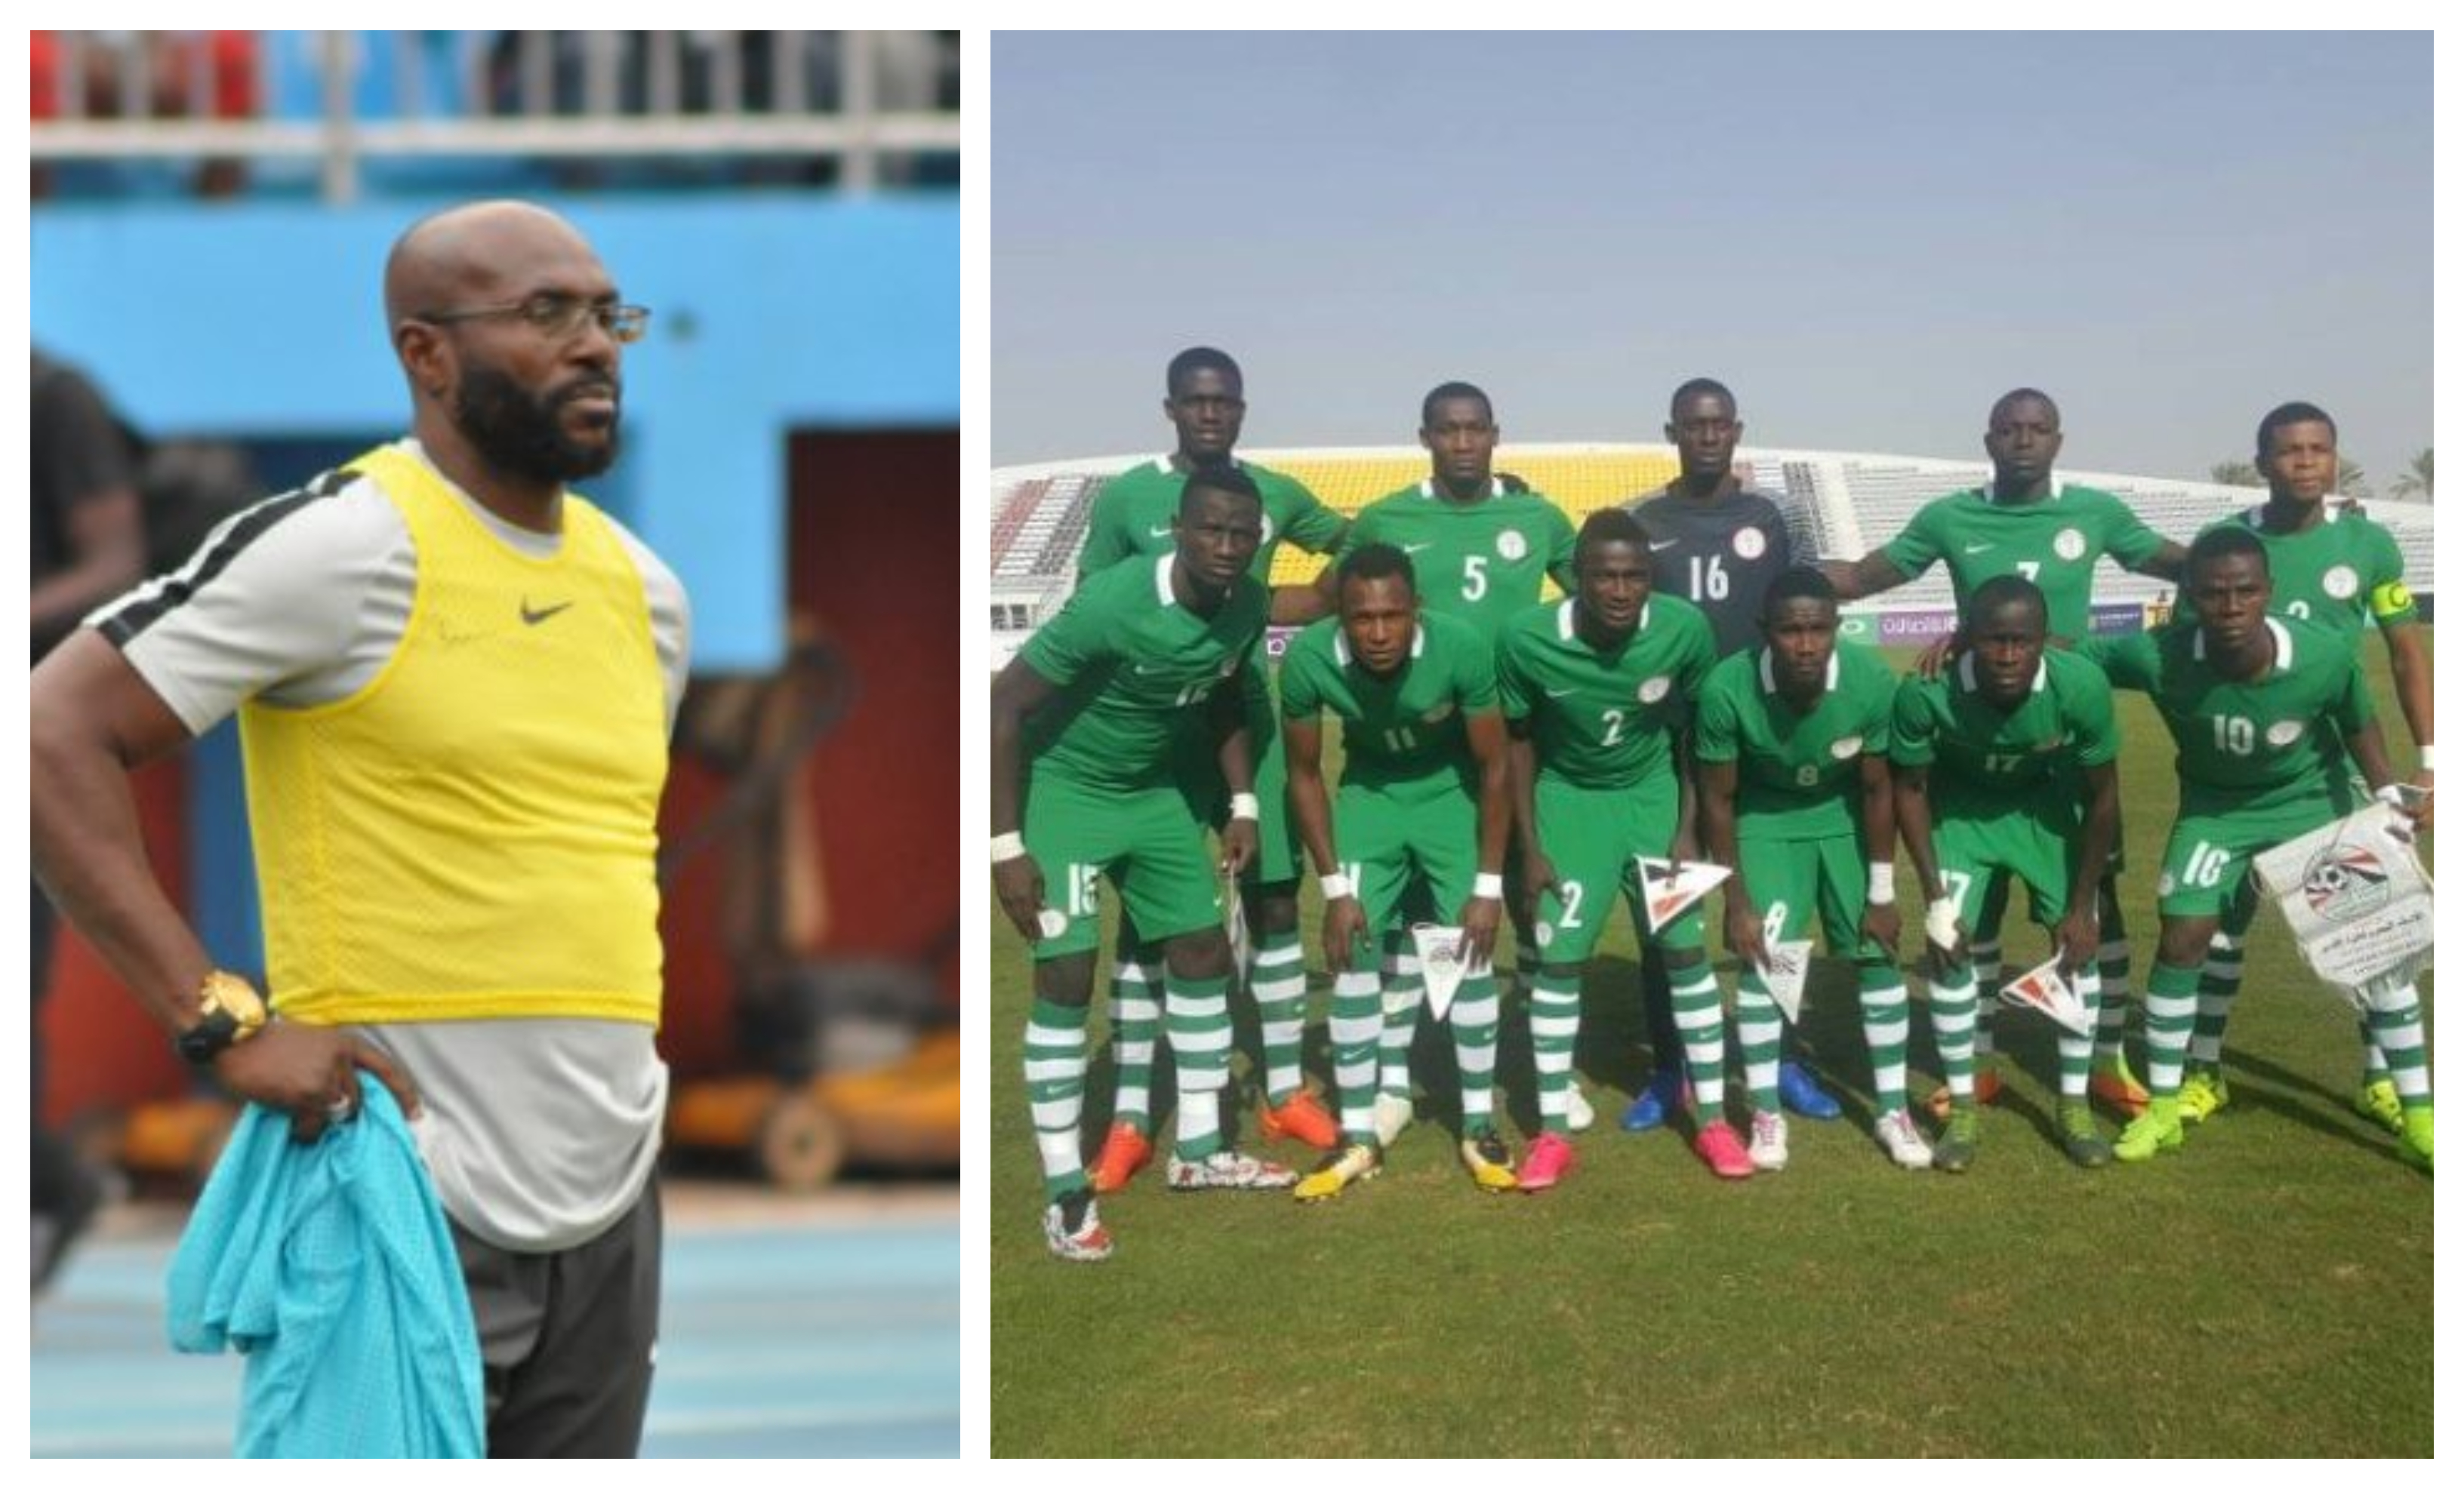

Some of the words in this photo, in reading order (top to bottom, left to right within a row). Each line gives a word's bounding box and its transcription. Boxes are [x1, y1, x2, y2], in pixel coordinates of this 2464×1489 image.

[1461, 555, 1487, 601] 5
[1690, 556, 1729, 601] 16
[1602, 711, 1623, 746] 2
[2214, 715, 2255, 755] 10
[1560, 882, 1582, 928] 2
